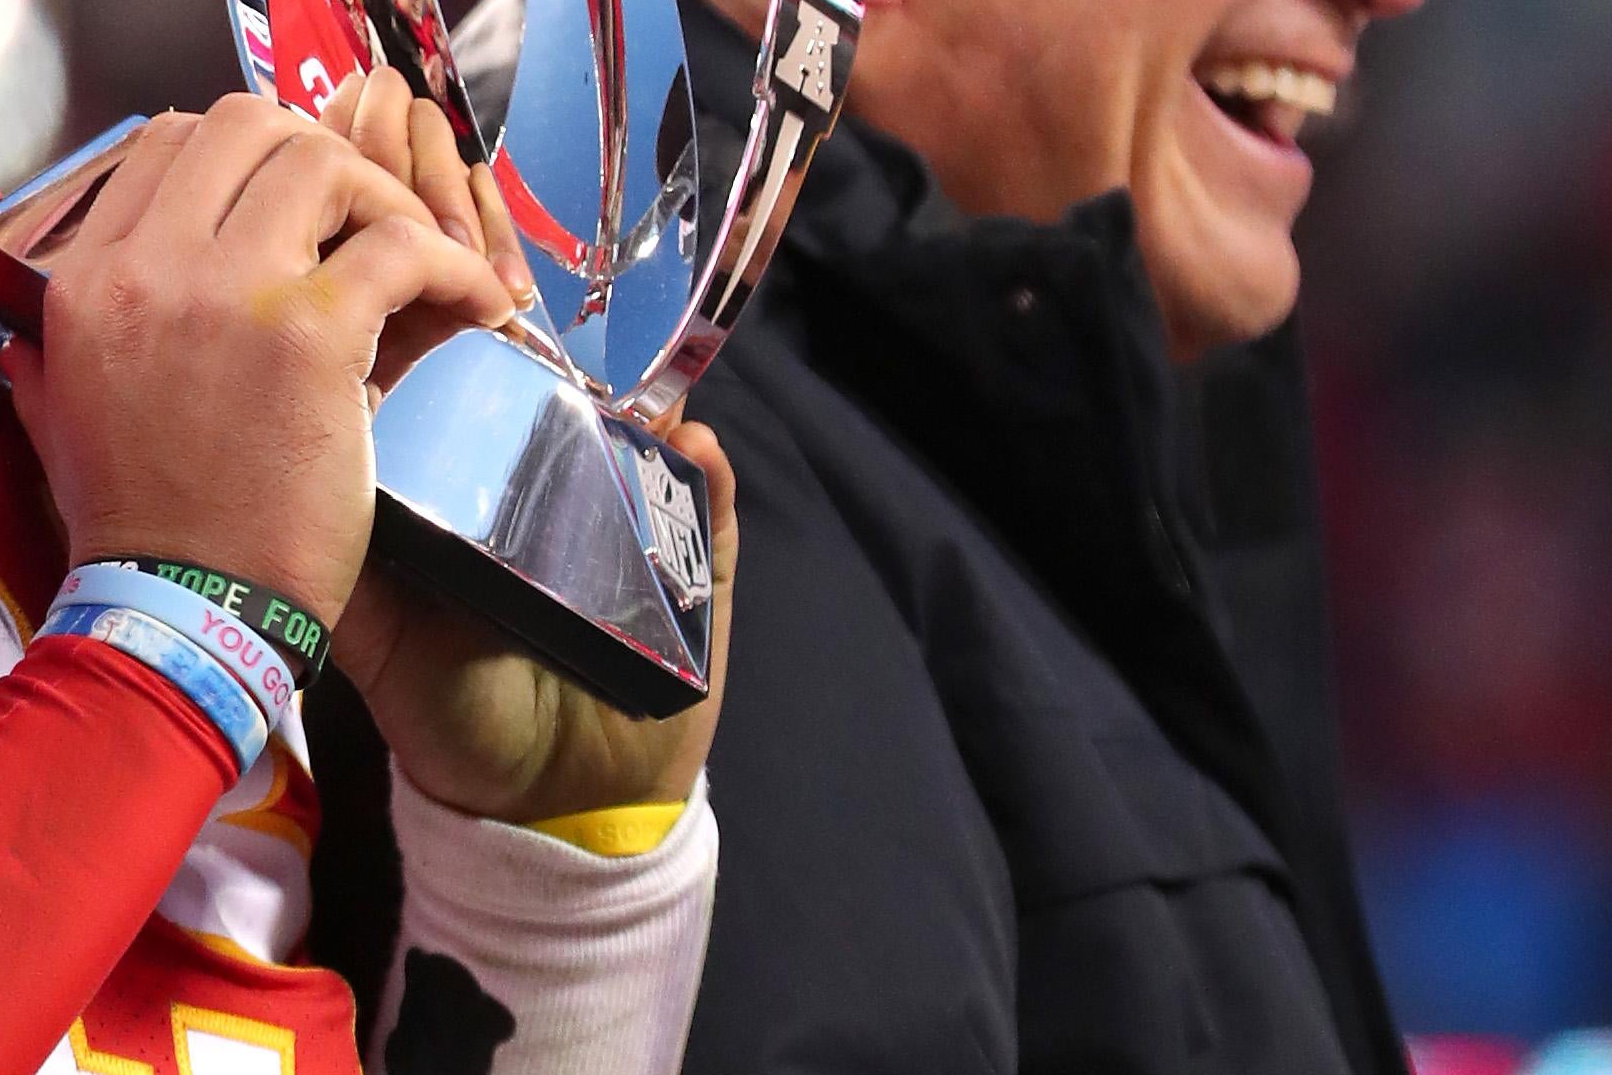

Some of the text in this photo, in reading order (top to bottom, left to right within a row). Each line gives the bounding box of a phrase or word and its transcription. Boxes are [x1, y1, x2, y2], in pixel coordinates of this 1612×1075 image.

[200, 607, 291, 706] YOU GO
[261, 597, 322, 659] FOR
